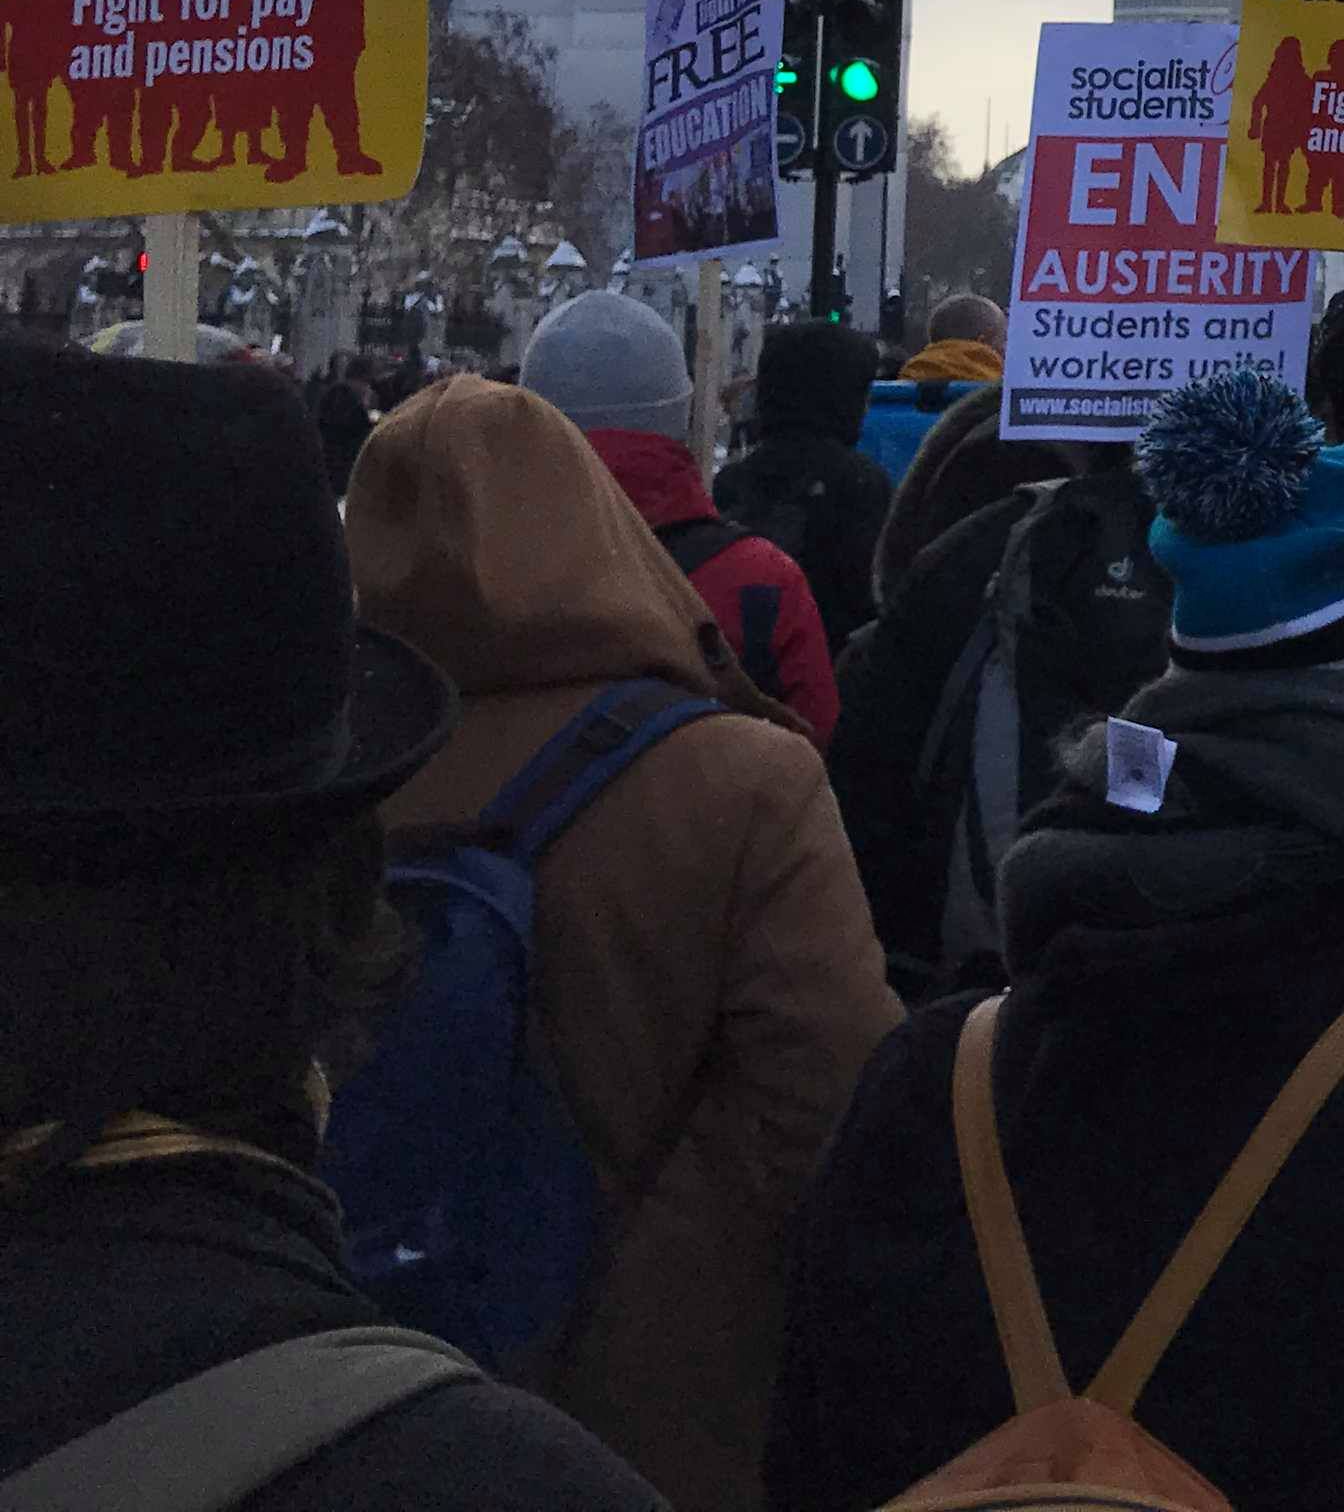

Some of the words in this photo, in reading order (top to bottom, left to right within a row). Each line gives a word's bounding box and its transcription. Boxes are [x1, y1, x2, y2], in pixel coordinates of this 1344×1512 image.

[68, 30, 135, 81] and
[145, 27, 314, 87] pensions
[646, 6, 766, 114] FREE
[1072, 59, 1210, 92] socialist
[644, 78, 768, 172] EDUCATION
[1068, 90, 1216, 121] students
[1069, 142, 1228, 226] EN
[1028, 249, 1304, 296] AUSTERITY
[1032, 307, 1190, 340] Students
[1204, 311, 1273, 340] and
[1030, 350, 1173, 381] workers
